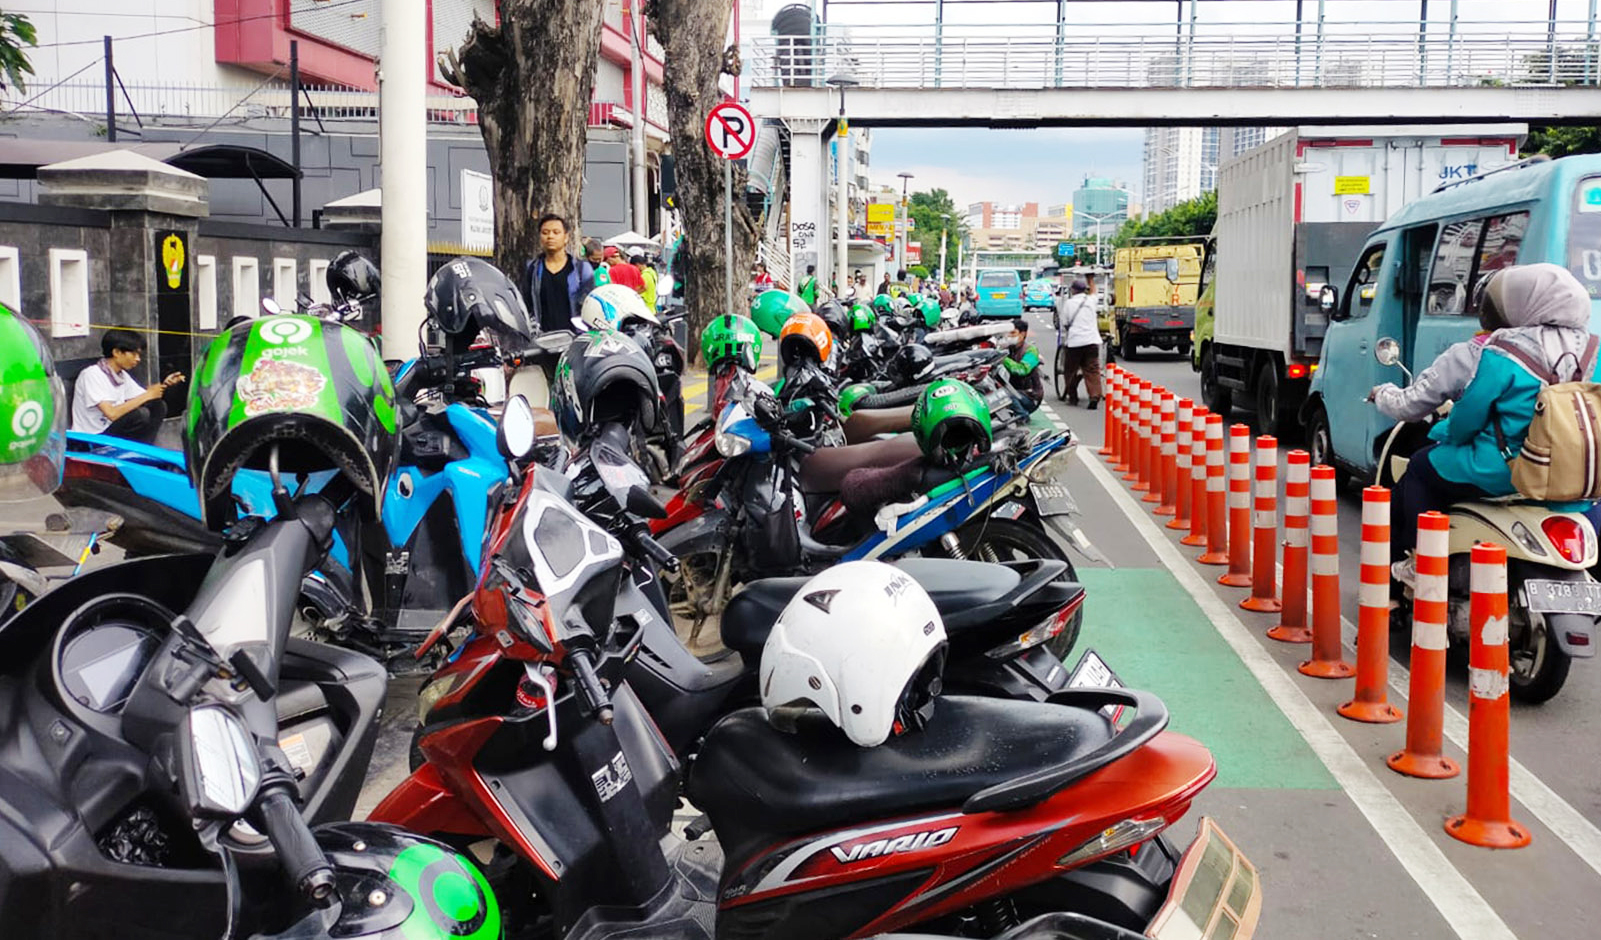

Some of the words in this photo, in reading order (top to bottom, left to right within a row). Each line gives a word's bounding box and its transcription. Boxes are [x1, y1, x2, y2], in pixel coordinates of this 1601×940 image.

[1439, 164, 1477, 179] JKT
[261, 346, 308, 360] gojek
[1529, 582, 1538, 595] B
[830, 826, 961, 863] VARIO
